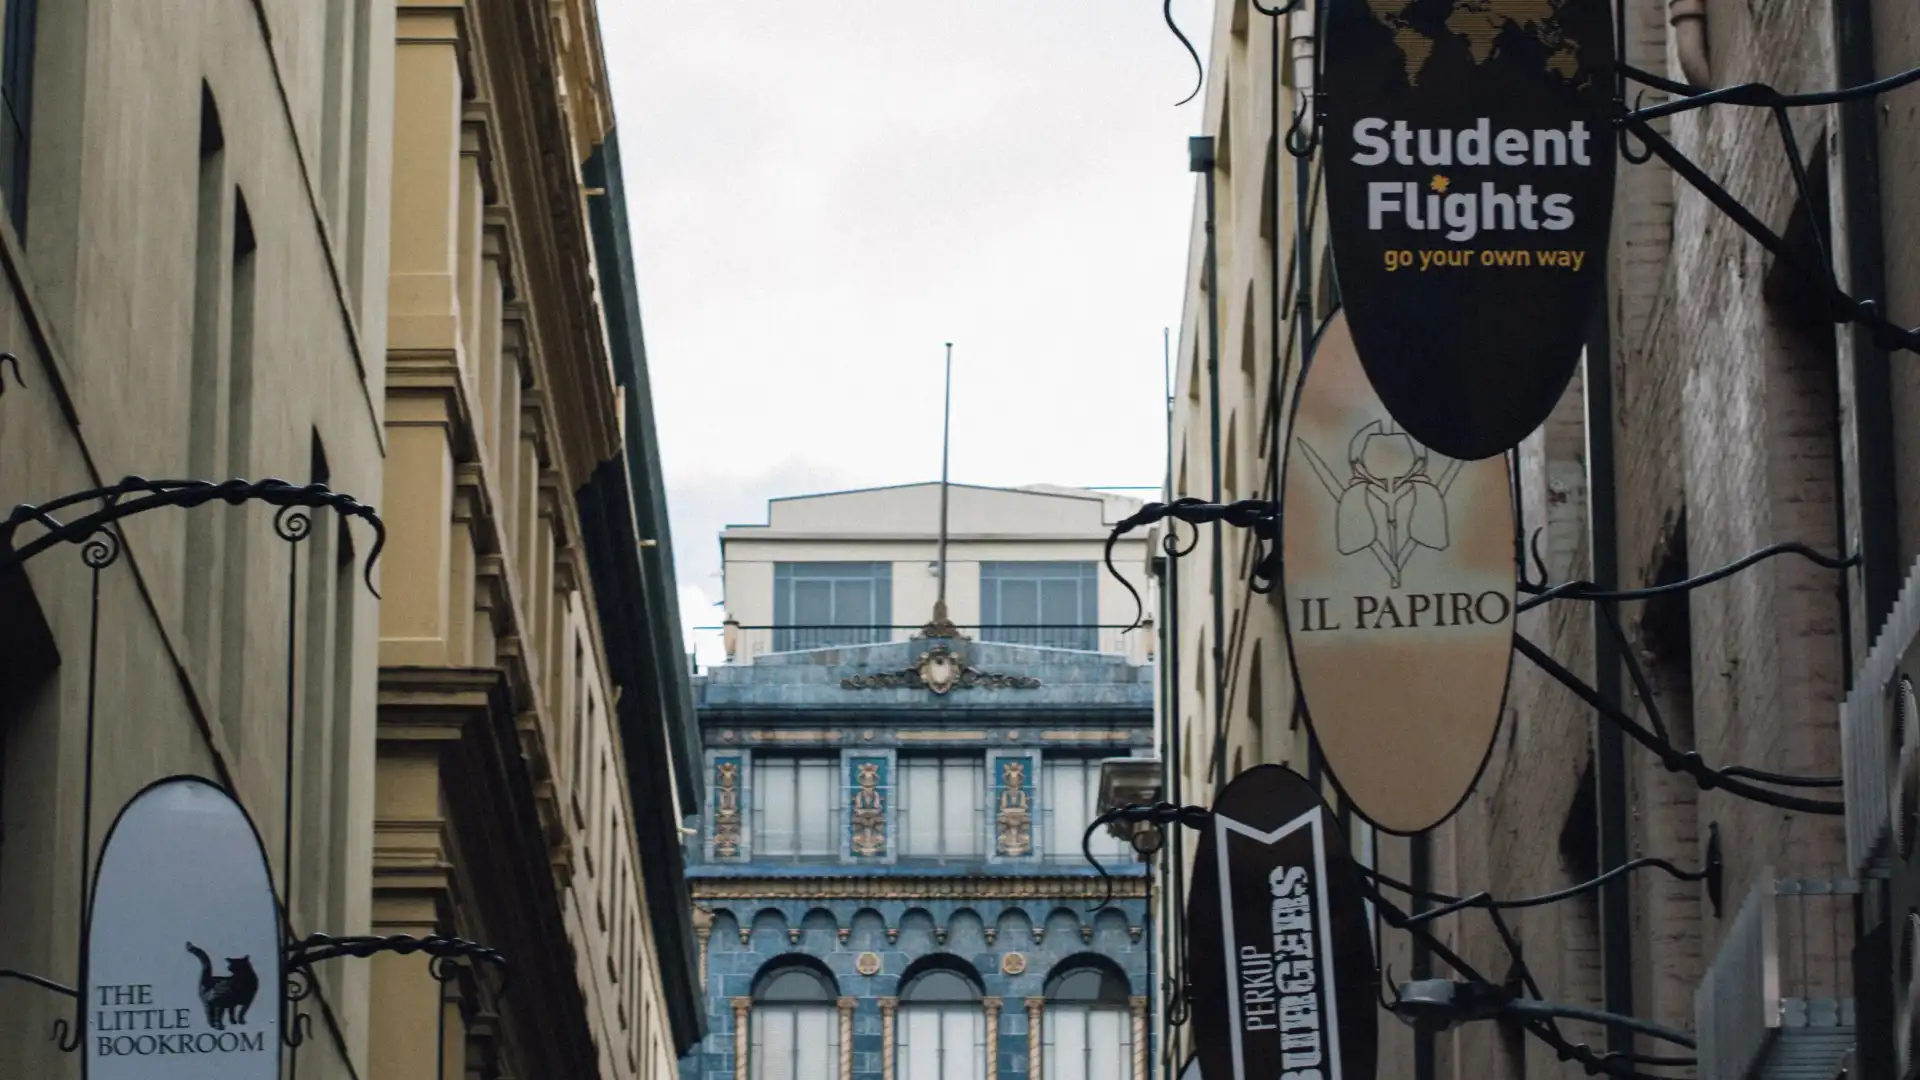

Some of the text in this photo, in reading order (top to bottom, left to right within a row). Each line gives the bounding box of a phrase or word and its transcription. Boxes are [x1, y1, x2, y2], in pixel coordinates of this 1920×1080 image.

[1351, 117, 1591, 166] Student
[1368, 174, 1575, 242] Flights
[1384, 250, 1585, 271] go your own way
[1299, 590, 1511, 632] IL PAPIRO
[97, 984, 153, 1007] THE
[1241, 945, 1277, 1031] PERKUP
[97, 1008, 190, 1031] LITTLE
[97, 1031, 265, 1057] BOOKROOM
